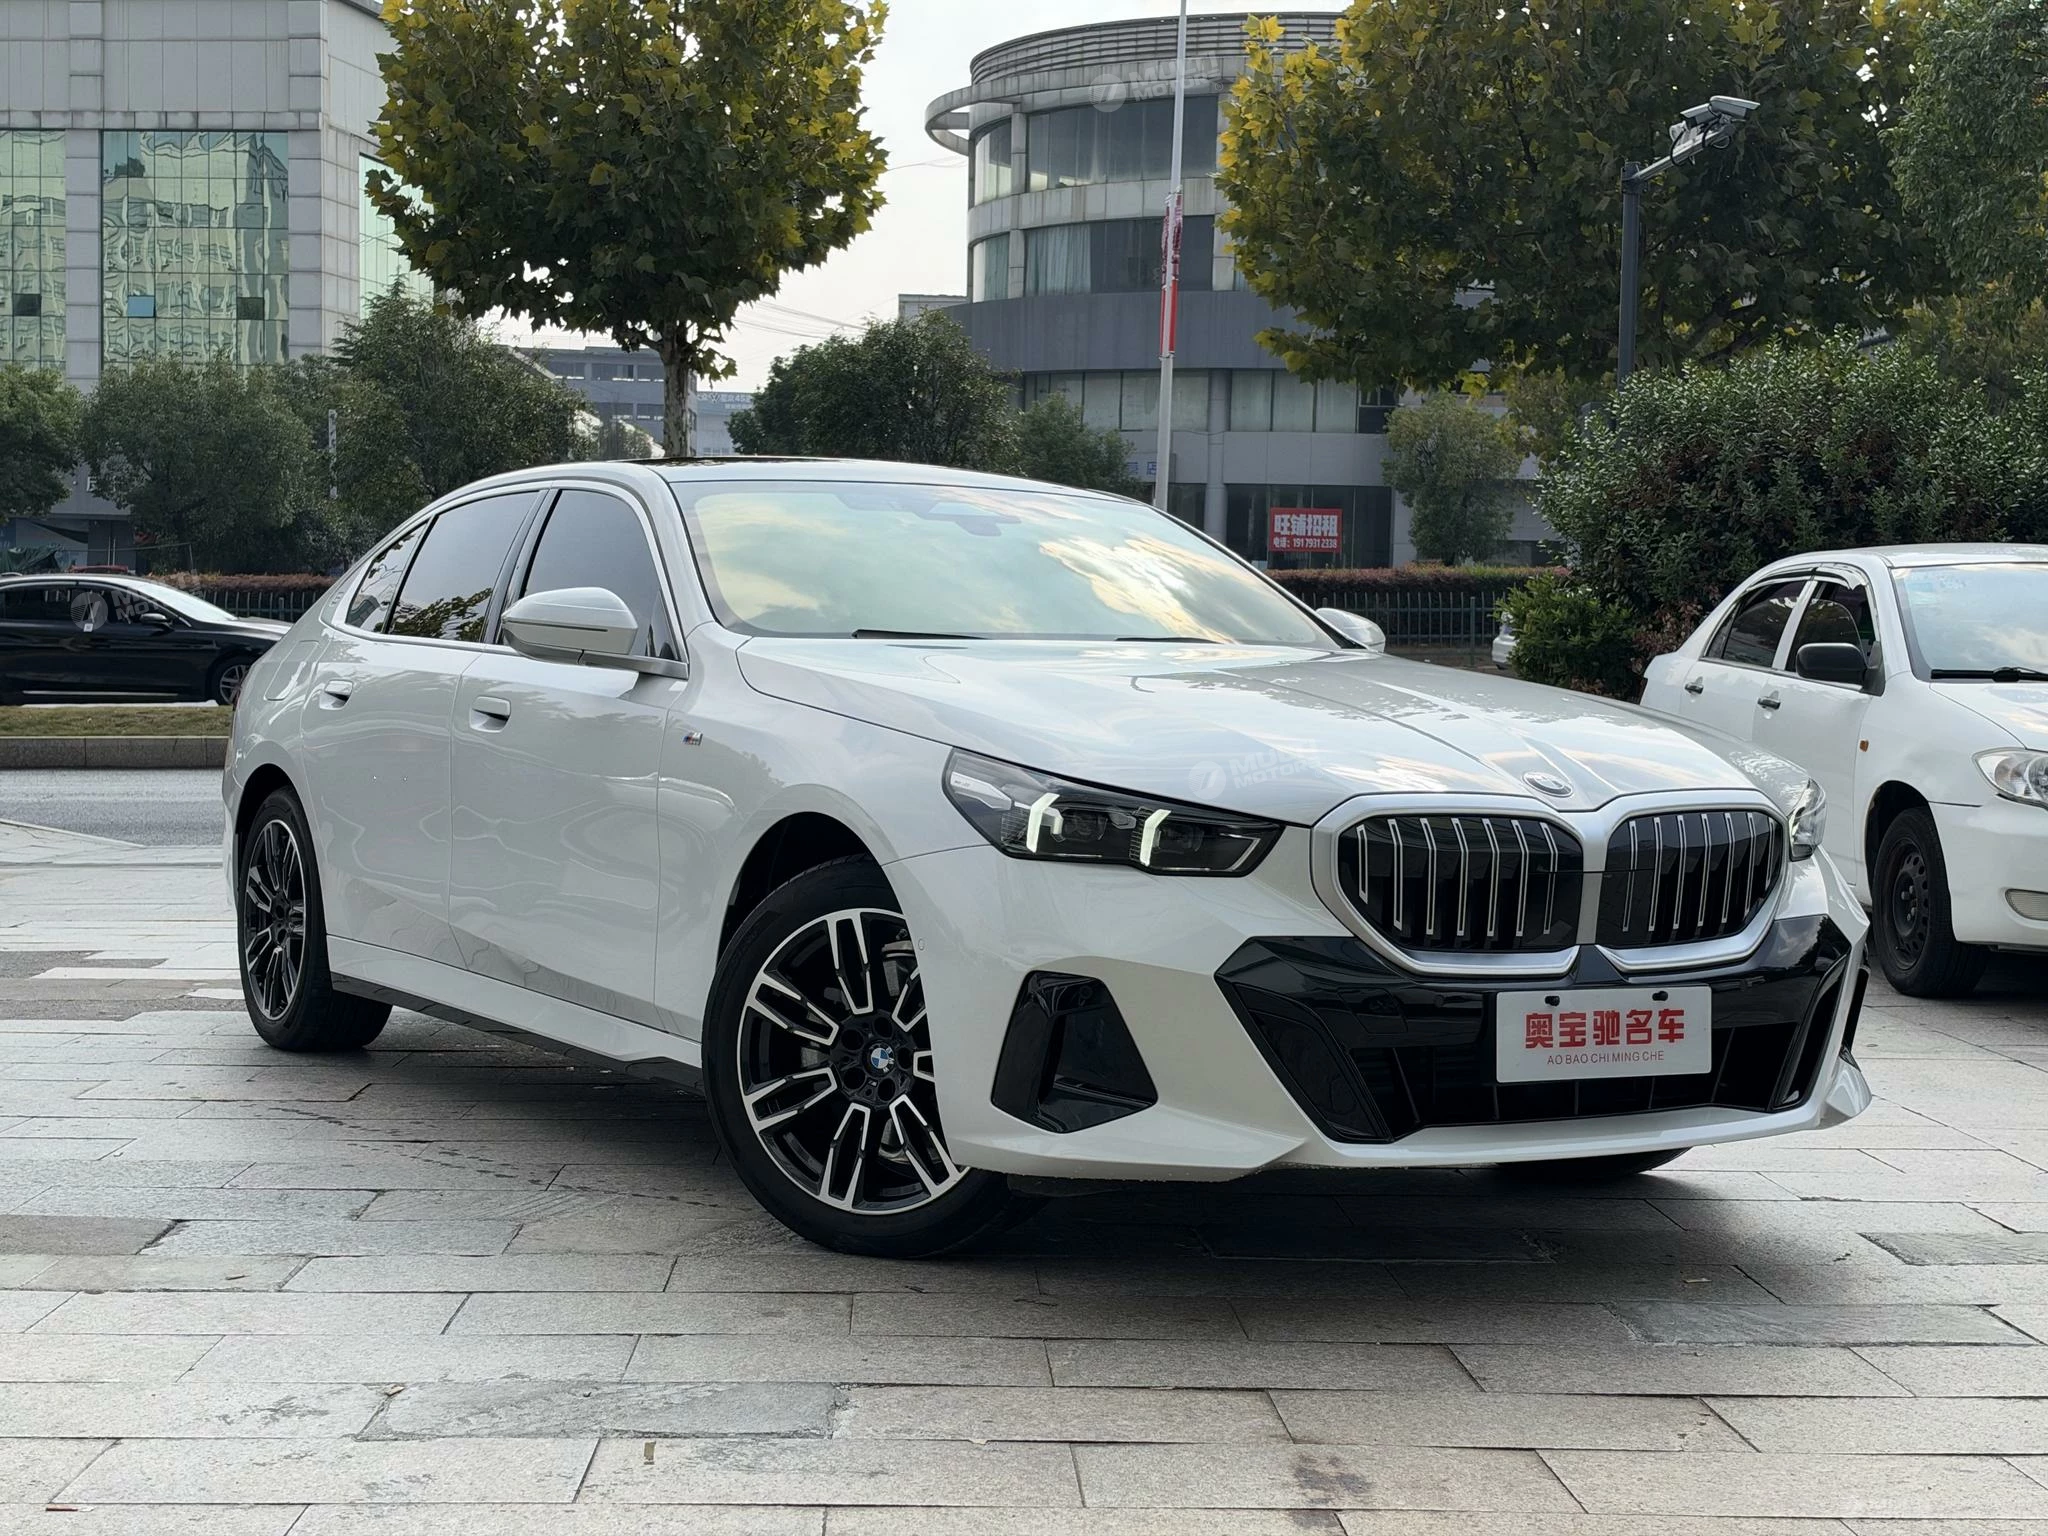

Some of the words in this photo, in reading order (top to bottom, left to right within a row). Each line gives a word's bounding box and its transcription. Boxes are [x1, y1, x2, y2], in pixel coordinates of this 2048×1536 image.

[1274, 514, 1338, 536] 旺铺招租
[1525, 1008, 1685, 1049] 奥宝驰名车
[1547, 1055, 1562, 1065] AO
[1565, 1053, 1588, 1064] BAO
[1591, 1053, 1610, 1063] CHI
[1612, 1051, 1640, 1062] MING
[1642, 1050, 1665, 1061] CHE
